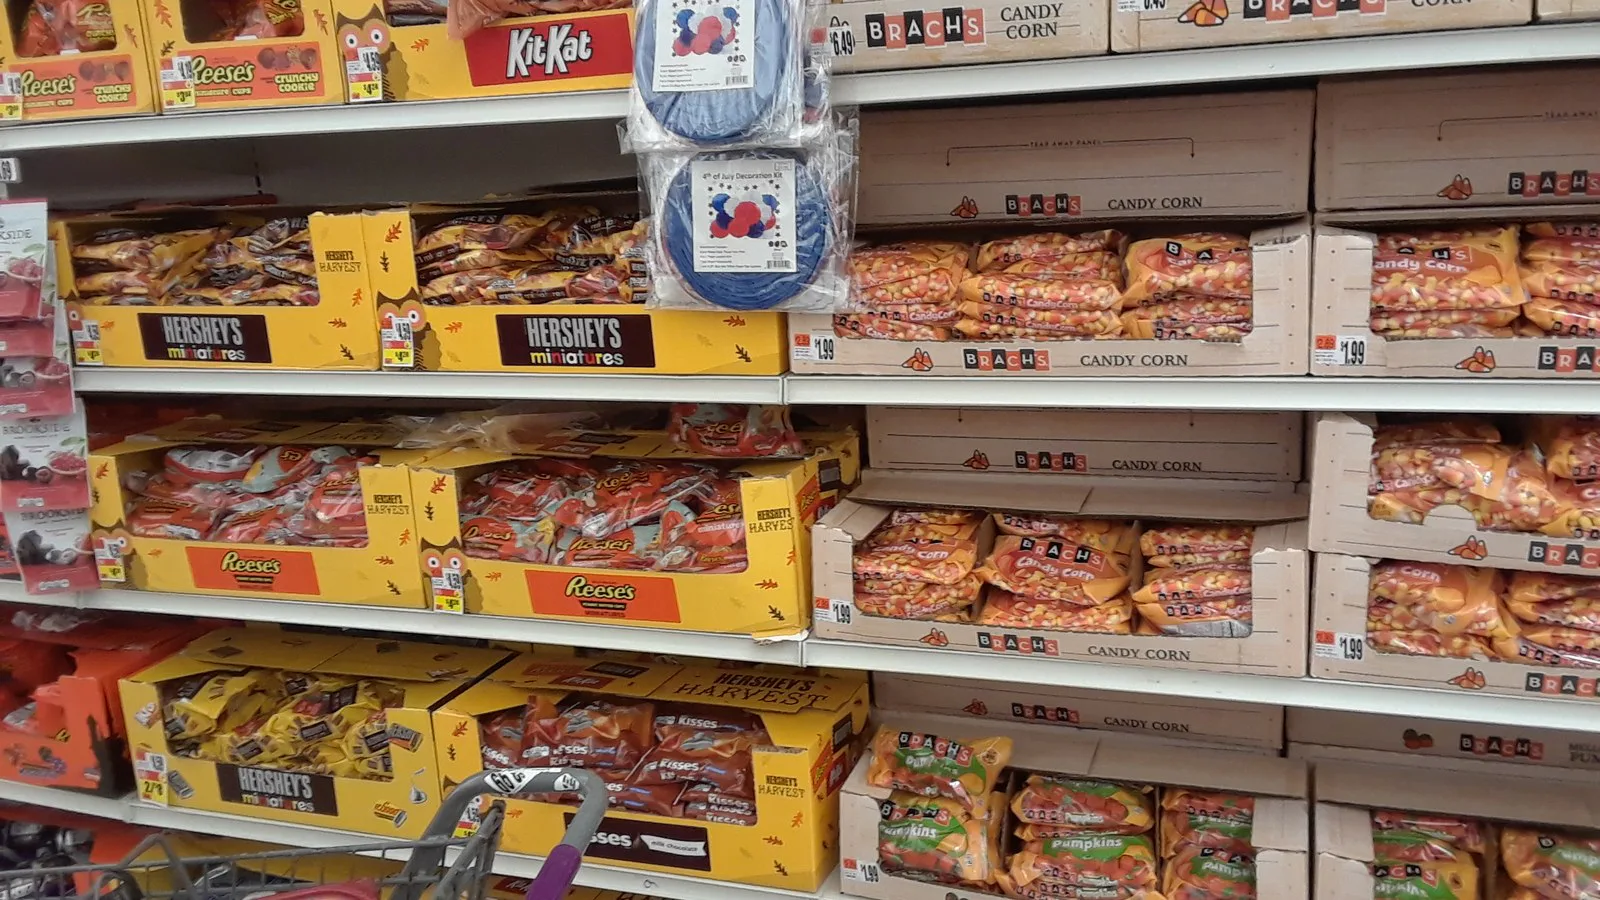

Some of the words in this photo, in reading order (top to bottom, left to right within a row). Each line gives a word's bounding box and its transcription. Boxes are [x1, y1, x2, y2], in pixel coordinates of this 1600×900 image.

[1000, 3, 1062, 22] CANDY
[867, 9, 984, 46] BRACH'S
[1005, 23, 1058, 40] CORN
[191, 55, 256, 87] Reese's
[21, 70, 78, 97] Reese's
[721, 172, 735, 181] July
[735, 172, 773, 180] Decoration
[773, 171, 783, 179] Kit
[1108, 200, 1156, 211] CANDY
[1160, 197, 1203, 209] CORN
[319, 261, 362, 273] HARVEST
[1374, 258, 1420, 272] andy
[1425, 259, 1469, 274] Corn
[162, 315, 244, 346] HERSHEY'S
[526, 315, 623, 349] HERSHEY'S
[168, 344, 246, 362] miniatures
[530, 348, 624, 367] miniatures
[814, 338, 834, 361] $1.99
[1340, 339, 1366, 366] $1.99
[1080, 354, 1138, 367] CANDY
[1141, 354, 1189, 367] CORN
[1112, 459, 1158, 471] CANDY
[1162, 460, 1202, 472] CORN
[917, 550, 949, 560] Corn
[1021, 538, 1105, 568] BRACH'S
[220, 551, 282, 575] Reese's
[1016, 556, 1059, 576] Candy
[1062, 567, 1095, 581] Corn
[1401, 565, 1441, 584] Corn
[565, 575, 637, 601] Reese's
[833, 602, 851, 624] $1.99
[1087, 645, 1141, 658] CANDY
[1145, 648, 1191, 662] CORN
[1339, 636, 1363, 661] $1.99
[713, 672, 816, 692] HERSHEY'S
[1526, 672, 1600, 697] BRAC
[674, 683, 829, 708] HARVEST
[677, 716, 718, 729] Kisses
[1104, 716, 1149, 730] CANDY
[1152, 719, 1190, 733] CORN
[659, 759, 699, 771] Kisses
[239, 766, 313, 800] HERSHEY'S
[758, 785, 806, 799] HARVEST
[590, 830, 632, 849] sses
[1051, 837, 1123, 852] Pumpkins
